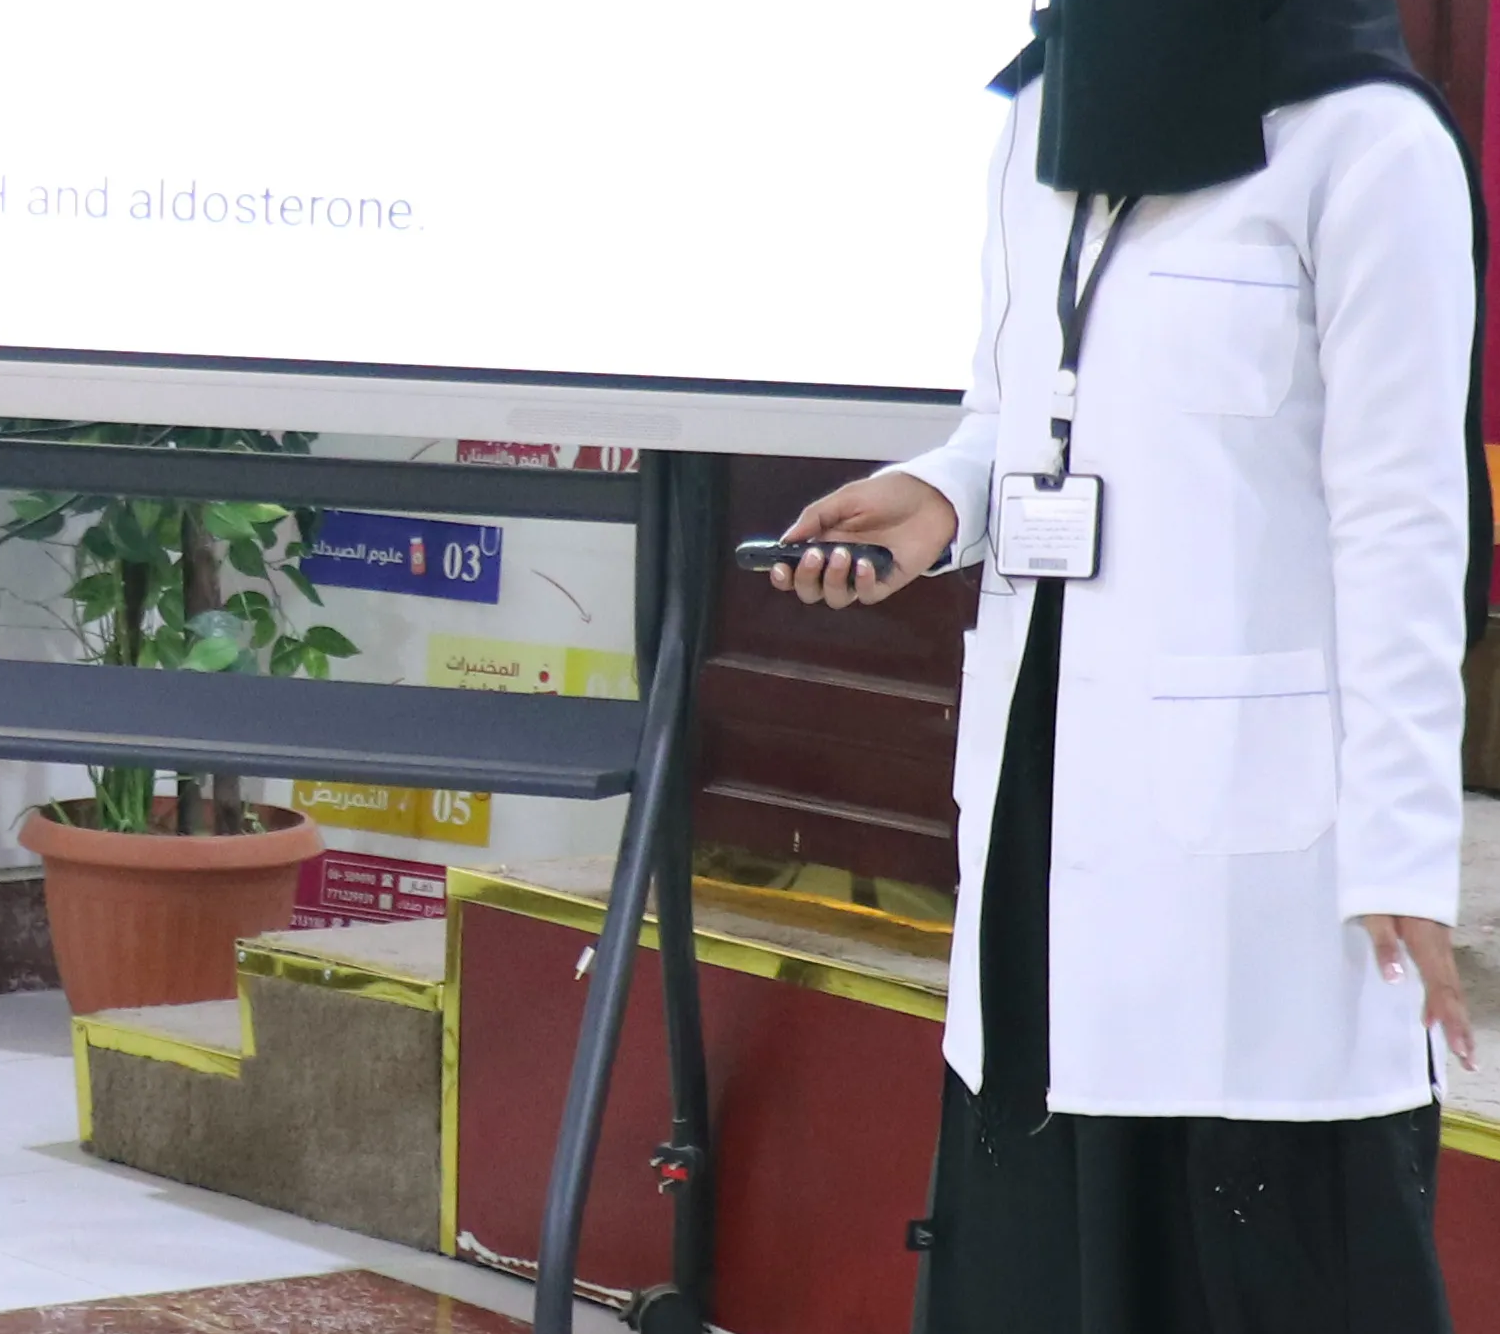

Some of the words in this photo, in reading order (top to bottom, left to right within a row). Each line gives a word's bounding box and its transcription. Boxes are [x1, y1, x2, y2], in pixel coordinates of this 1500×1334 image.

[26, 175, 109, 221] and
[126, 179, 425, 235] aldosterone.
[443, 542, 482, 582] 03
[432, 788, 472, 826] 05
